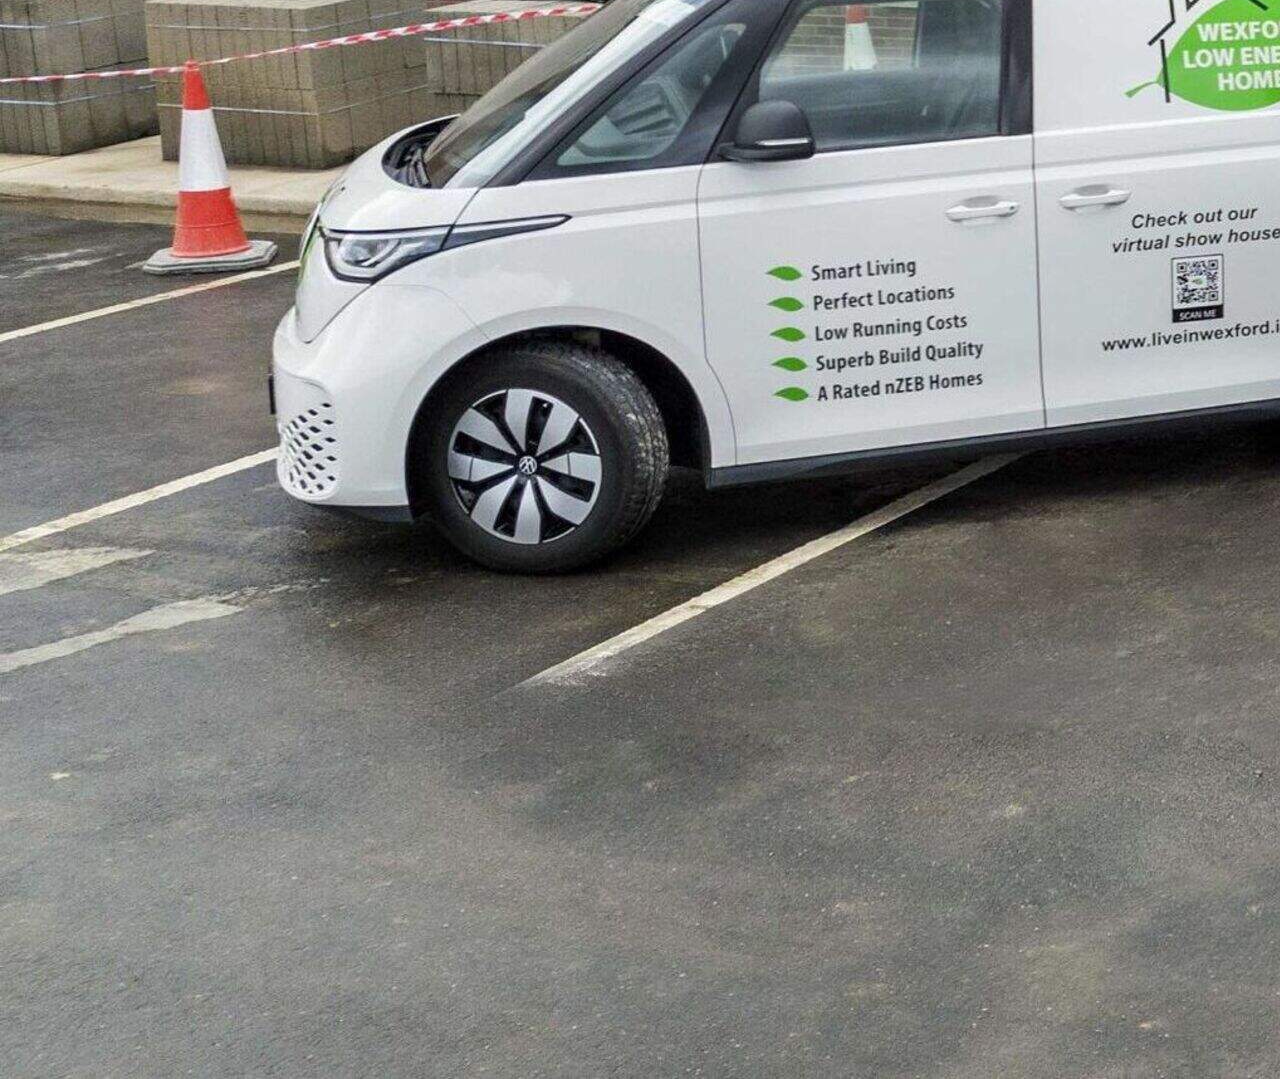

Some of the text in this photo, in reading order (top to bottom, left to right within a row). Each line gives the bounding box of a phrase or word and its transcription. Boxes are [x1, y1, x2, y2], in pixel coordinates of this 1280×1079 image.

[1183, 48, 1234, 69] LOW
[1131, 206, 1258, 229] Check out our
[1112, 235, 1170, 253] virtual
[1174, 232, 1223, 248] show
[811, 259, 917, 281] Smart Living
[813, 286, 955, 311] Perfect Locations
[815, 314, 968, 341] Low Running Costs
[816, 341, 984, 373] Superb Build Quality
[817, 373, 983, 402] A Rated nZEB Homes
